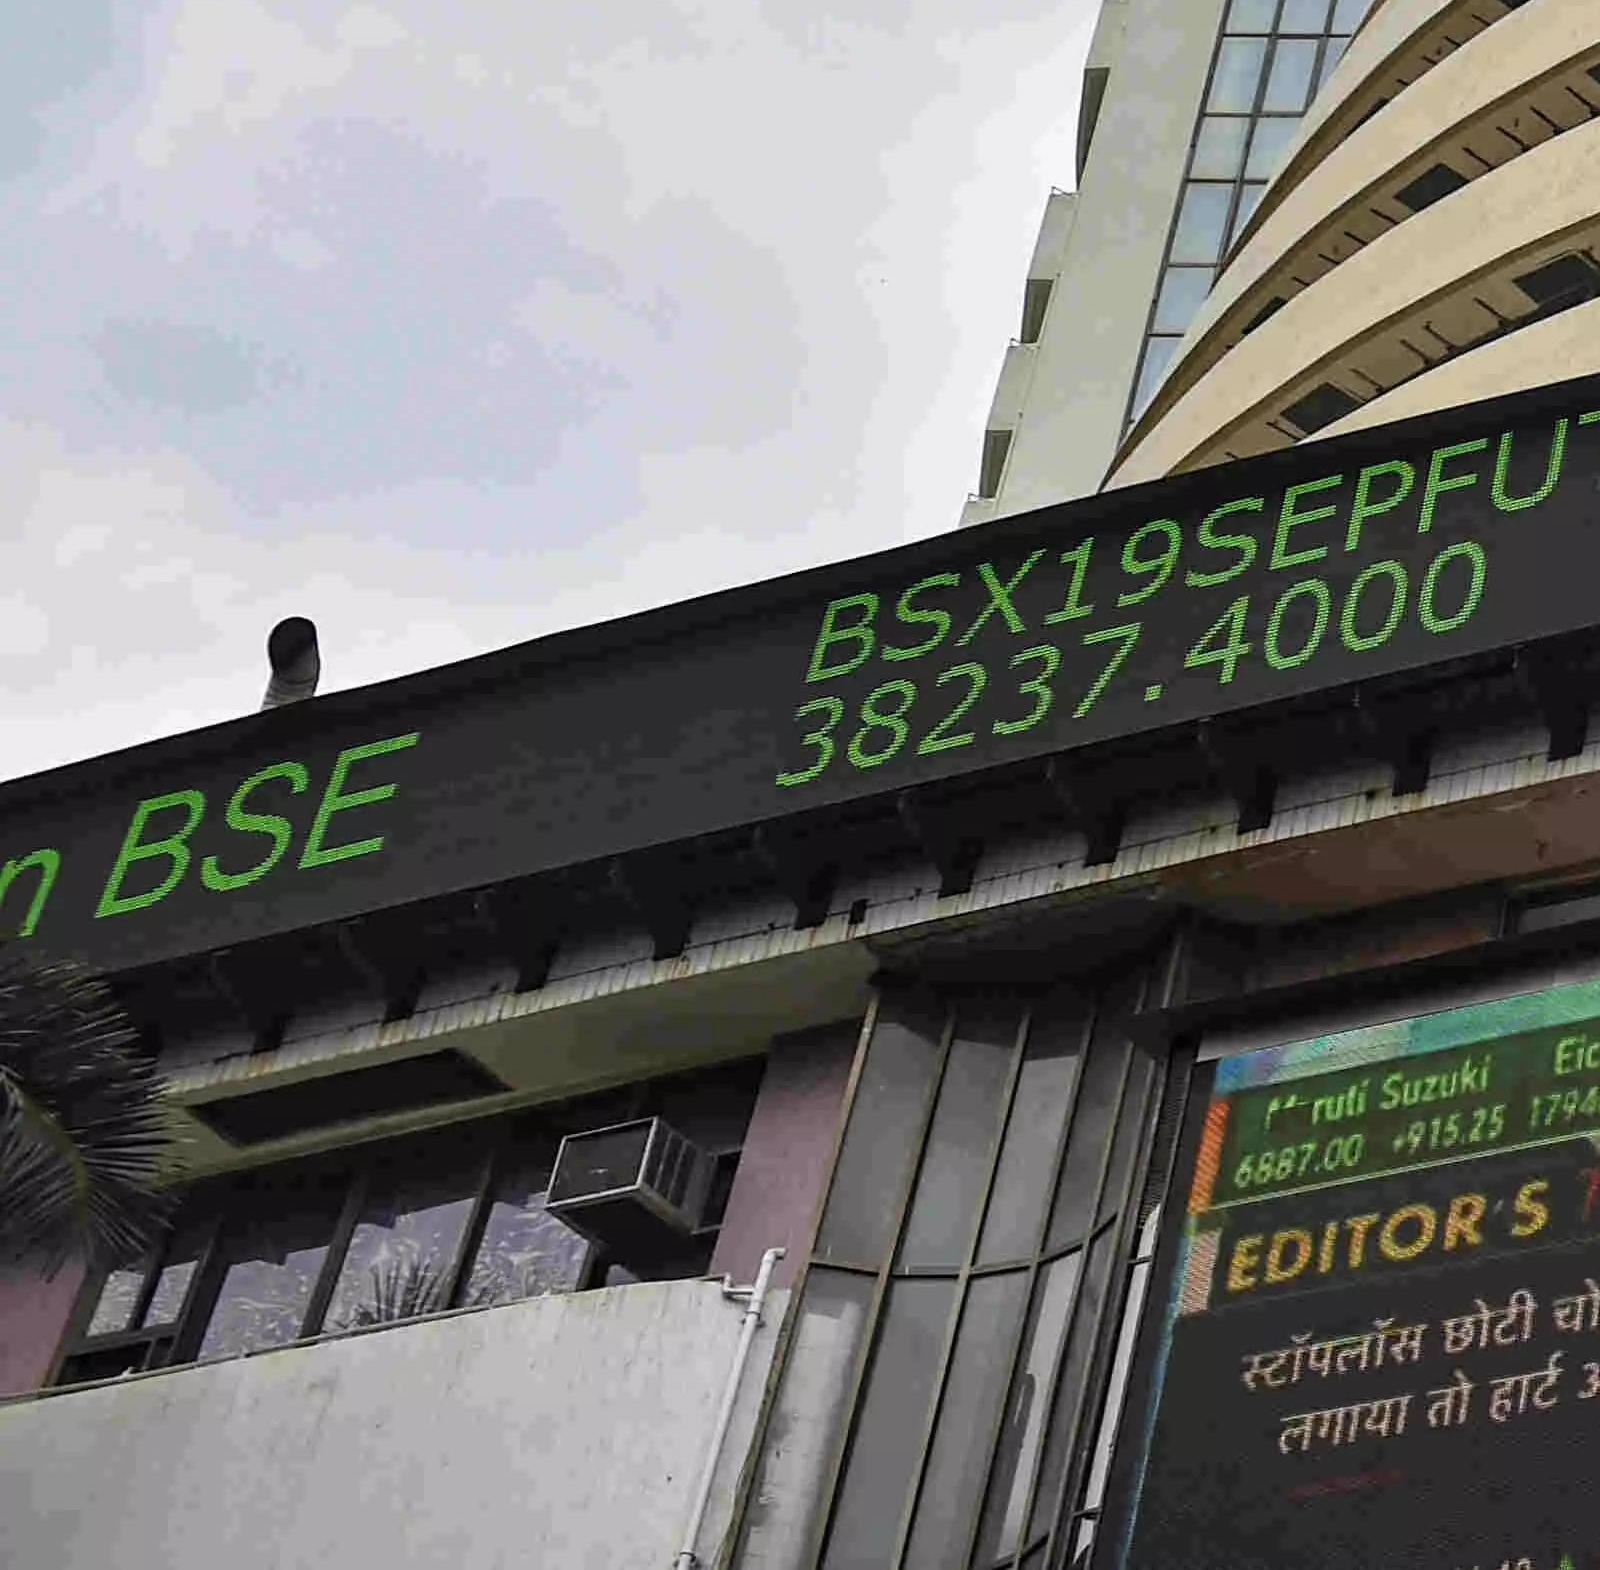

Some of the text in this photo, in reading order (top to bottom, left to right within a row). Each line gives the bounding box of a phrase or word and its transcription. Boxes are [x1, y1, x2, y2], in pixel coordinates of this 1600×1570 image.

[775, 540, 1487, 788] 38237.4000
[94, 732, 421, 919] BSE
[1379, 1054, 1493, 1112] Suzuki
[1233, 1132, 1365, 1190] 6887.00
[1442, 1288, 1539, 1355] छोटी
[1278, 1392, 1416, 1456] लगाया
[1424, 1368, 1476, 1428] तो
[1487, 1349, 1566, 1424] हार्ट
